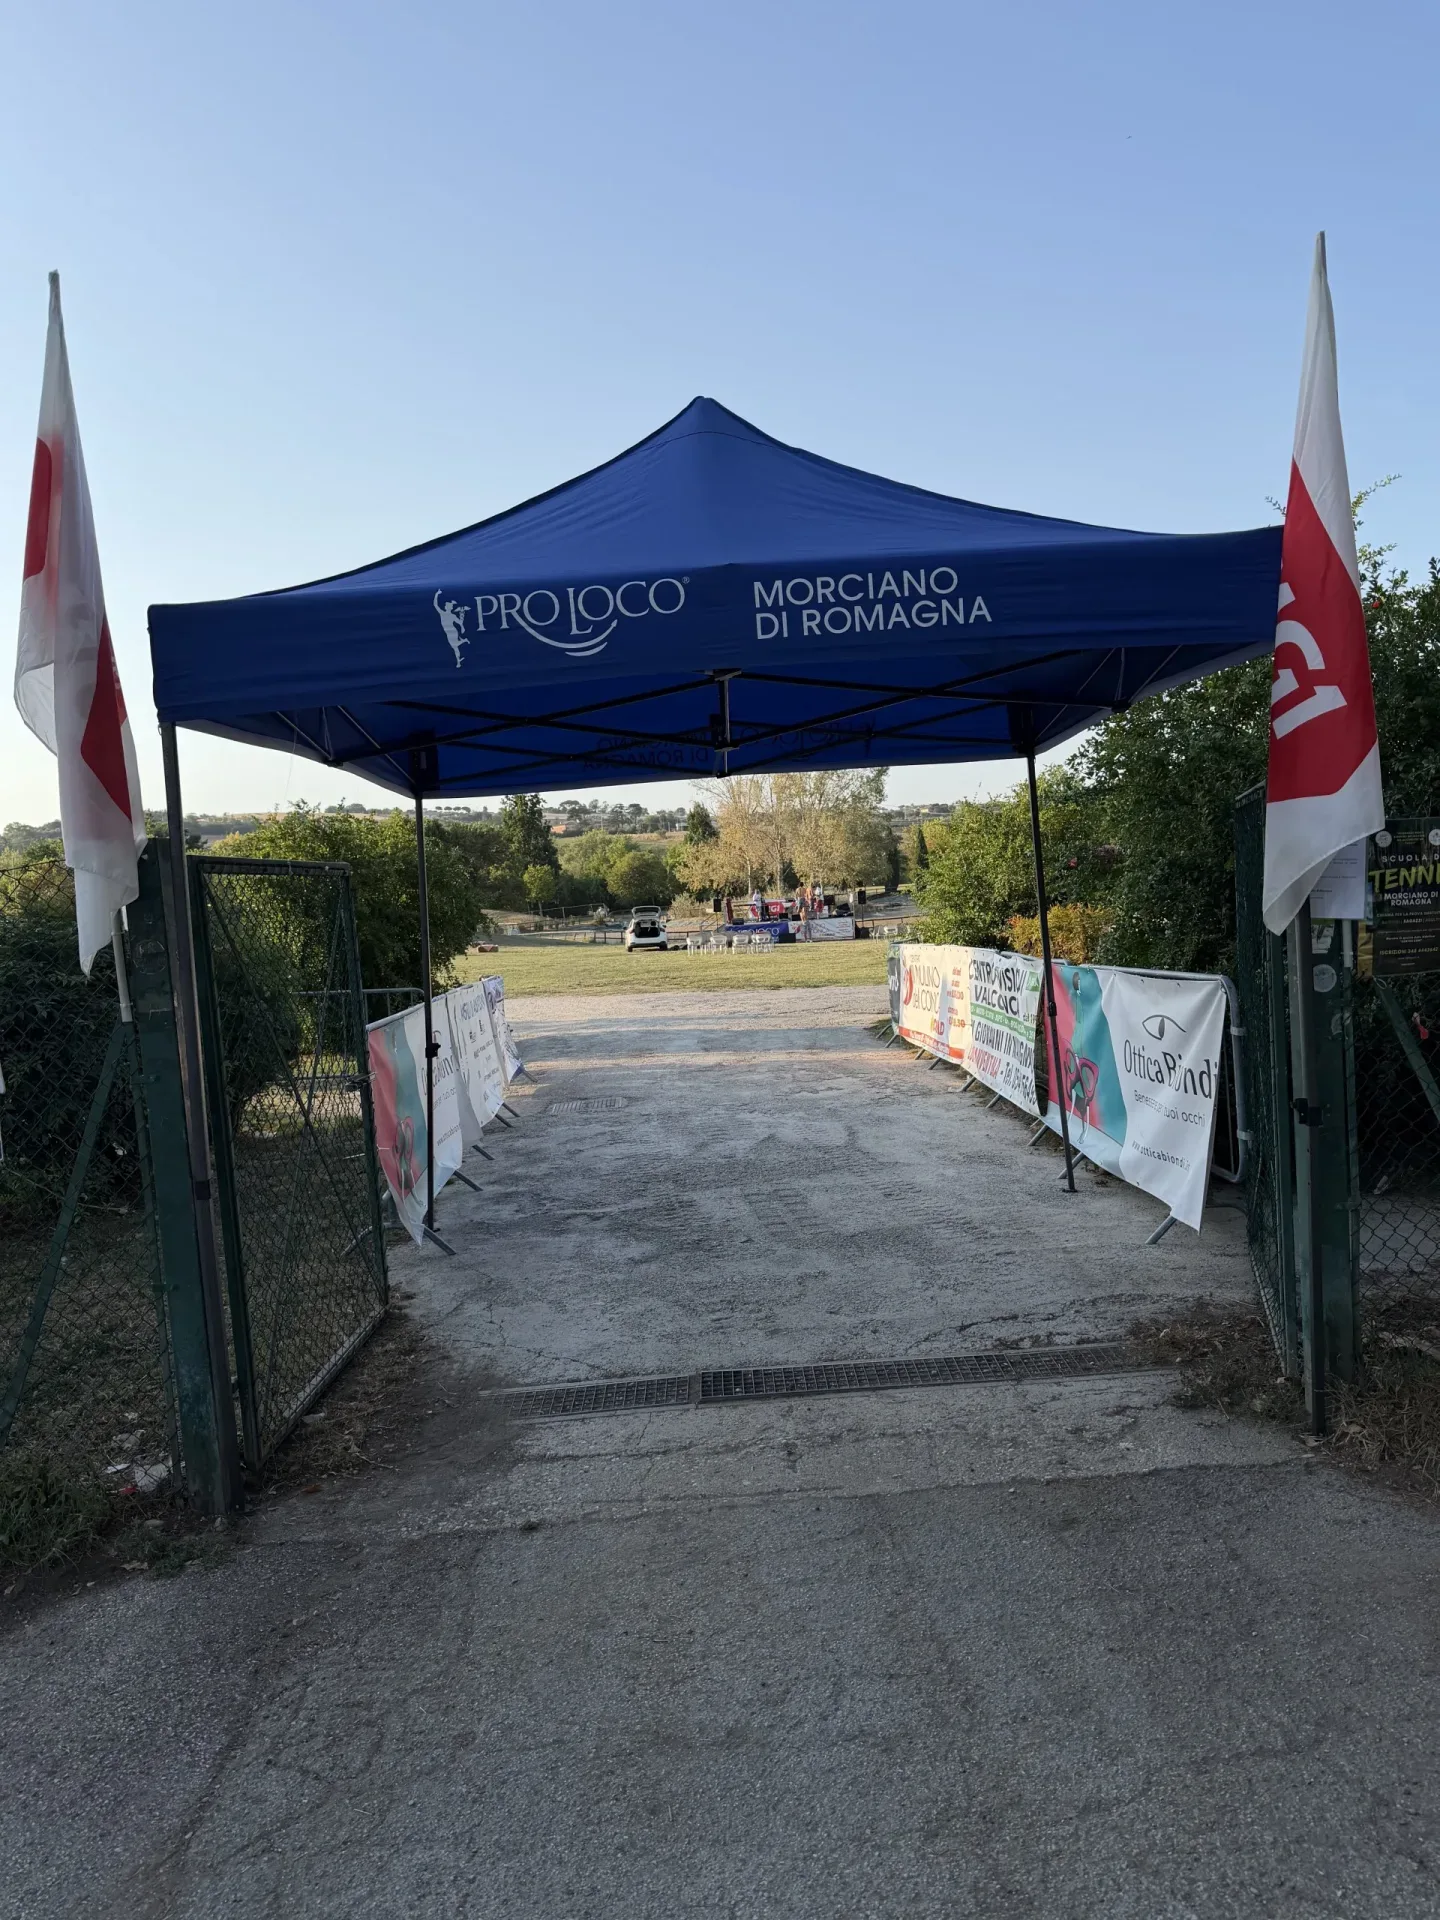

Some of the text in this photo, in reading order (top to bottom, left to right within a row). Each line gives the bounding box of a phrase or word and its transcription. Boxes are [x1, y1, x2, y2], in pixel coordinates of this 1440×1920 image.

[753, 566, 959, 609] MORCIANO
[474, 578, 686, 635] PRO LOCO
[755, 595, 993, 640] DI ROMAGNA
[1382, 854, 1428, 862] SCUOLA
[1368, 863, 1440, 893] TENNI
[1384, 891, 1428, 900] MORCIANO
[1391, 898, 1432, 907] ROMAGNA
[1181, 1111, 1206, 1128] occhi
